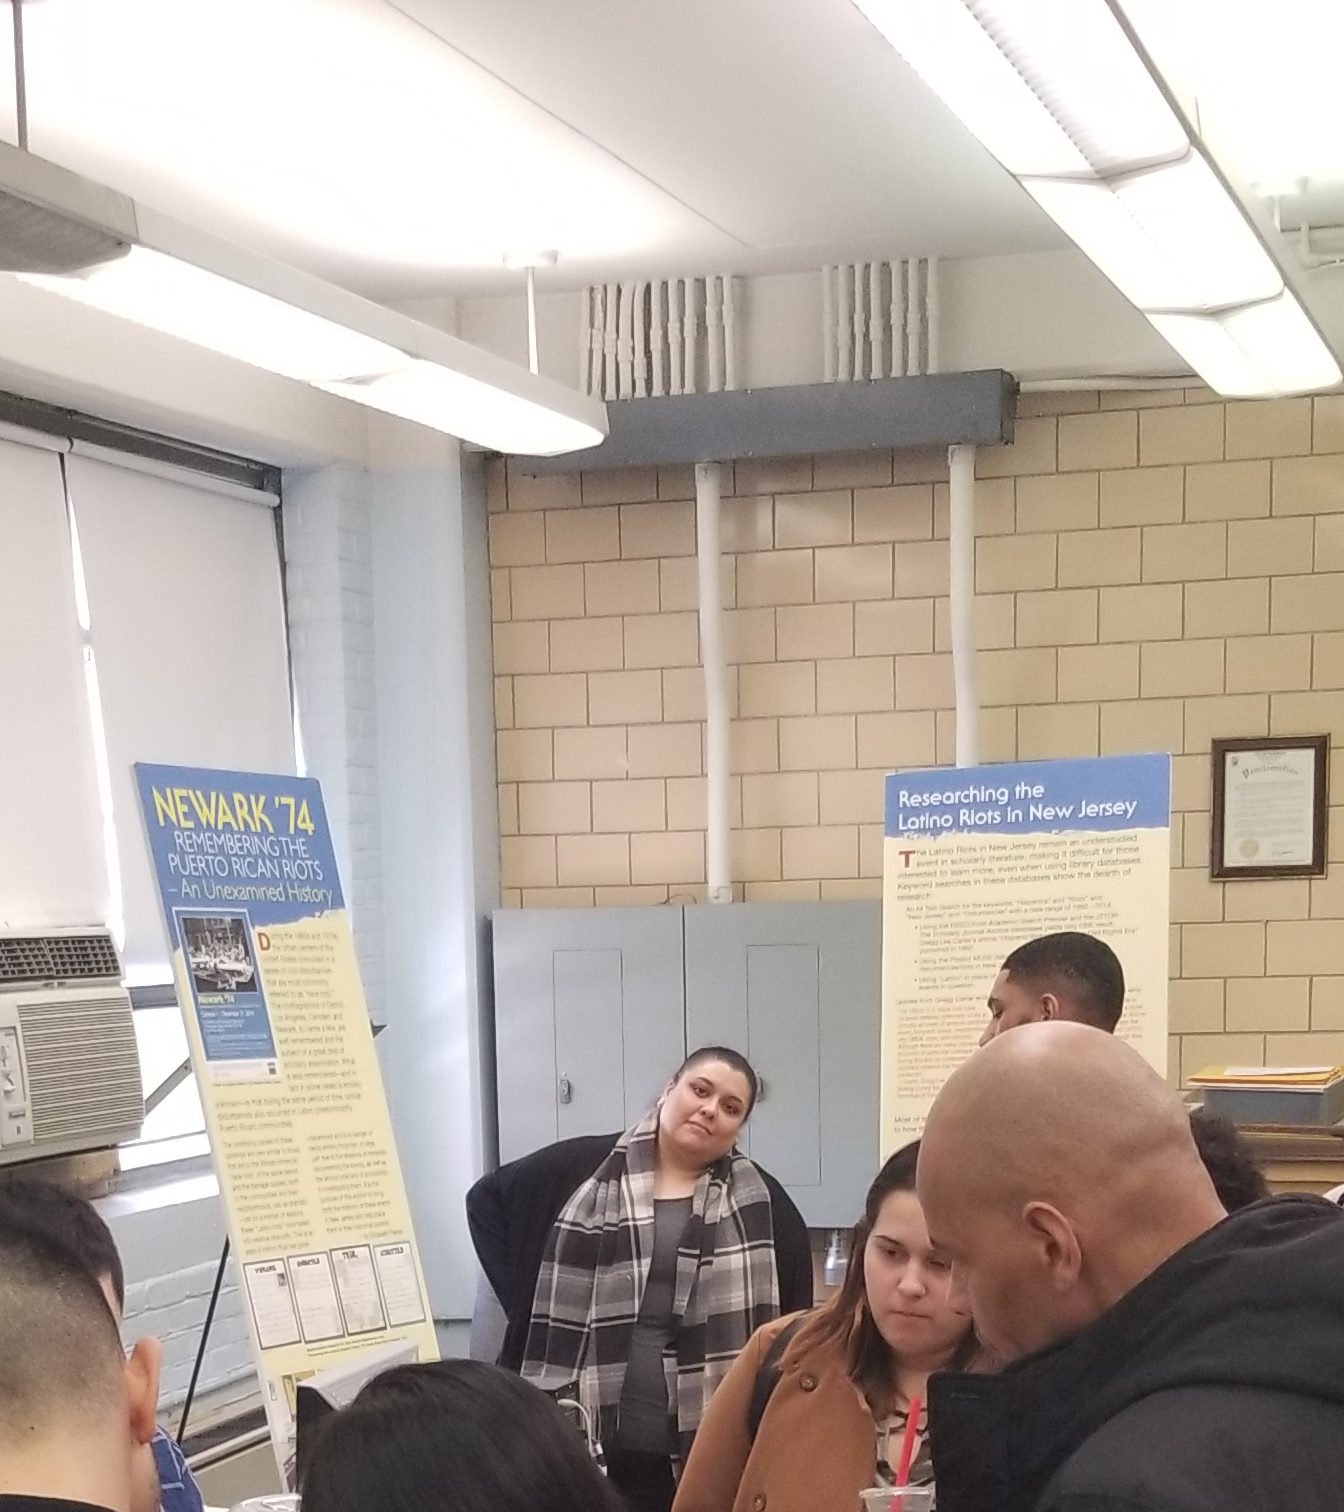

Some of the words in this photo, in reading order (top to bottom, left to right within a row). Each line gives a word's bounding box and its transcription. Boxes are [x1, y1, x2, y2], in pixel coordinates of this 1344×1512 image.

[1242, 764, 1298, 779] Proclamation
[899, 785, 1009, 808] Researching
[1015, 782, 1045, 799] the
[152, 786, 274, 833] NEWARK
[275, 796, 315, 835] '74
[898, 812, 953, 831] Latino
[959, 809, 1001, 826] Riots
[1007, 807, 1022, 823] in
[1029, 804, 1074, 821] New
[1078, 799, 1137, 820] Jersey
[174, 831, 280, 857] REMEMBERING
[279, 837, 310, 858] THE
[899, 849, 927, 868] The
[929, 848, 954, 856] Latino
[957, 846, 977, 854] Riots
[1009, 842, 1036, 851] Jersey
[1039, 840, 1067, 848] remain
[1082, 835, 1138, 845] understudied
[950, 857, 986, 865] scholarly
[1029, 851, 1059, 860] making
[1069, 848, 1100, 858] difficult
[1116, 846, 1140, 854] those
[168, 853, 228, 877] PUERTO
[232, 857, 280, 879] RICAN
[283, 859, 323, 880] RIOTS
[897, 870, 937, 878] interested
[1020, 863, 1042, 871] when
[1044, 862, 1067, 870] using
[1069, 860, 1095, 869] library
[181, 878, 201, 898] An
[205, 880, 285, 902] Unexamined
[288, 883, 332, 907] History
[897, 881, 933, 891] Keyword
[935, 880, 971, 888] searches
[1053, 872, 1076, 880] show
[1093, 870, 1120, 878] dearth
